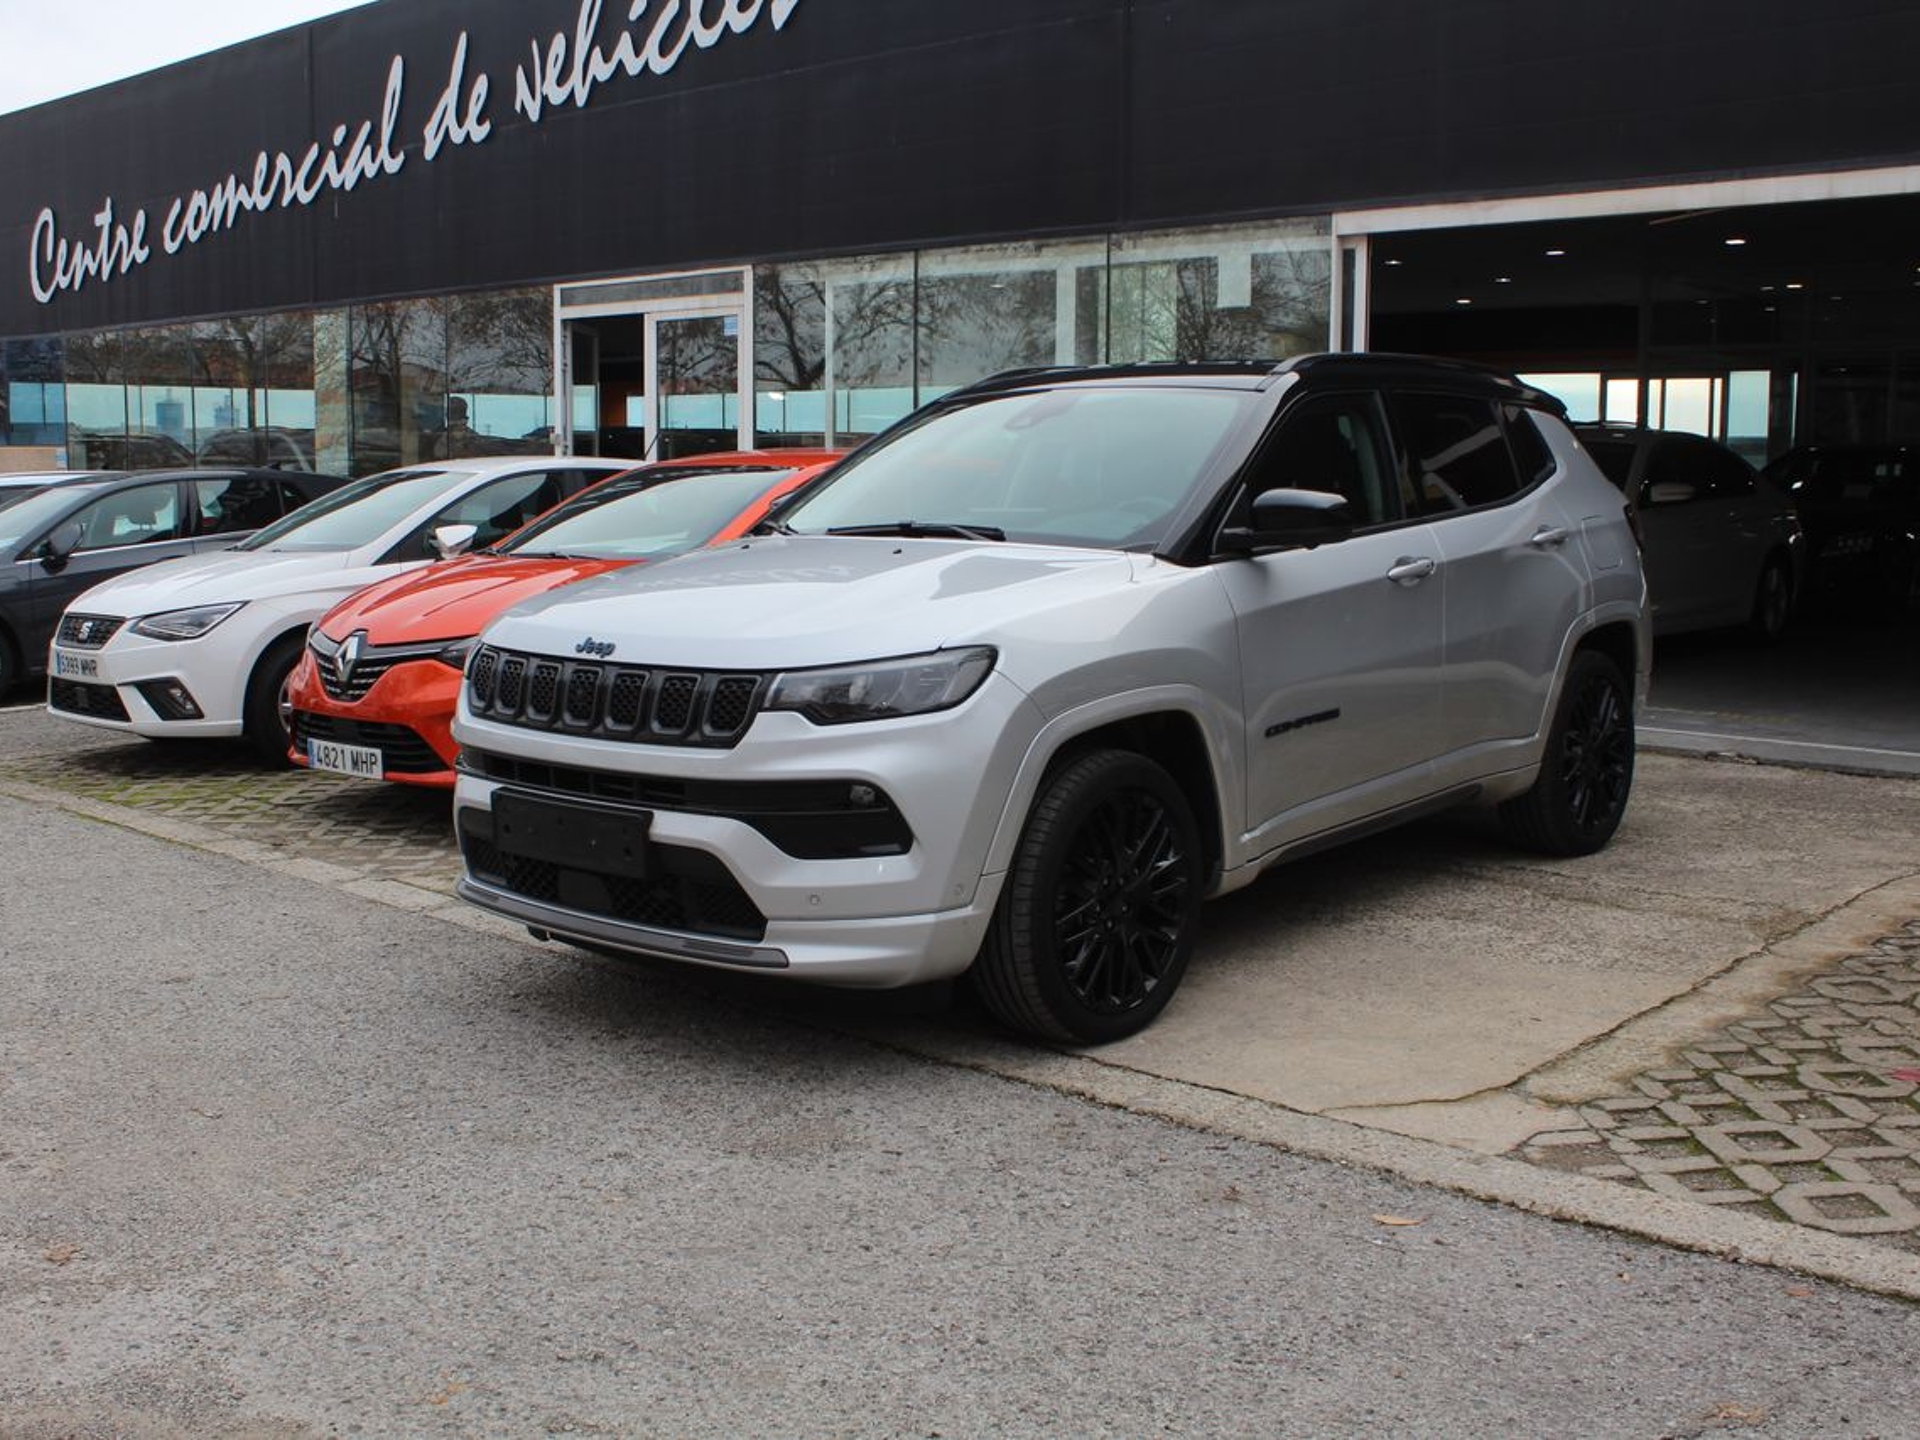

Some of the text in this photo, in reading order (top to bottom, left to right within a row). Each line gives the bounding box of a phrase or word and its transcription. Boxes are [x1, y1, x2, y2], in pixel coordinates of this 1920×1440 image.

[29, 196, 150, 304] Centre
[162, 54, 405, 255] comercial
[423, 30, 491, 161] de
[575, 636, 616, 659] Jeep
[316, 743, 378, 775] 4821 MHP
